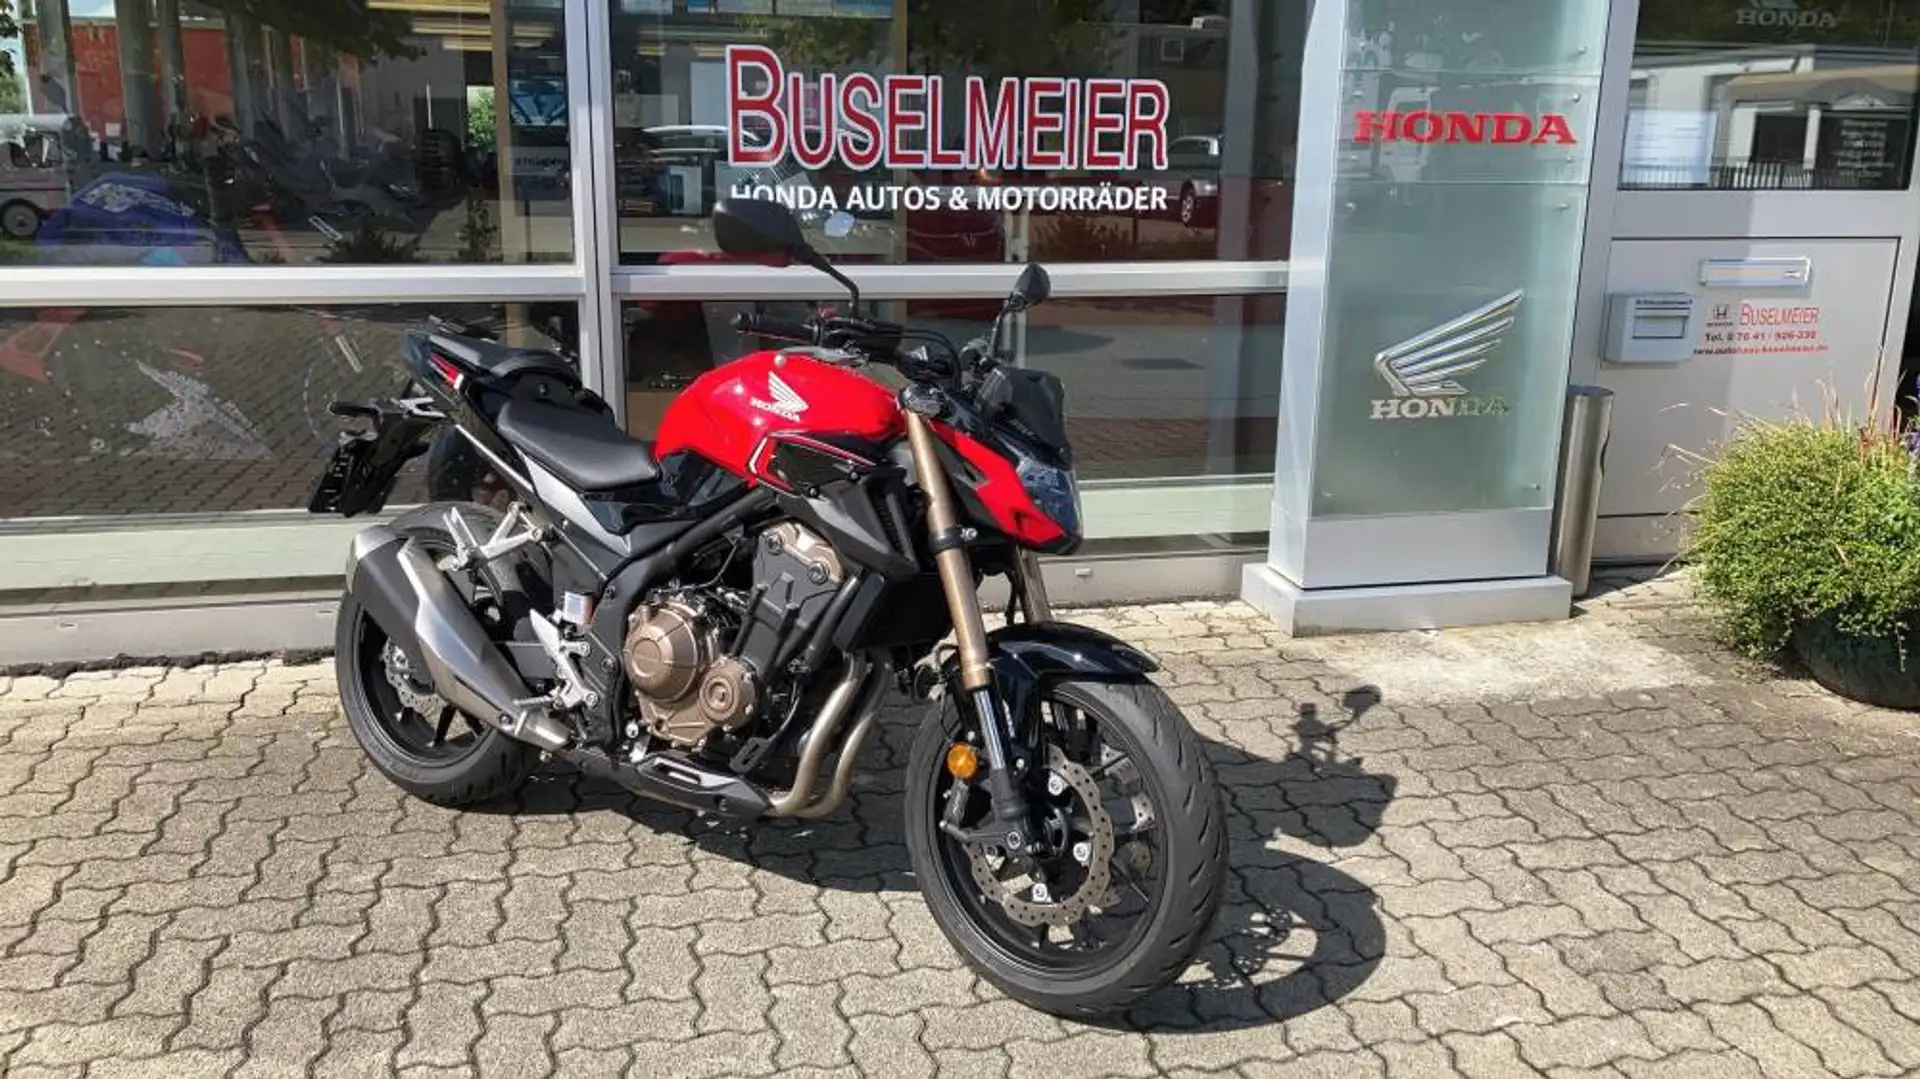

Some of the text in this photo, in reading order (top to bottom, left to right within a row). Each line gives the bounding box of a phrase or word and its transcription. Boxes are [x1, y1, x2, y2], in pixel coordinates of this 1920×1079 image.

[1736, 9, 1838, 28] HONDA
[1352, 109, 1578, 146] HONDA
[846, 184, 940, 211] AUTOS
[948, 184, 970, 211] &
[976, 181, 1168, 211] MOTORRÄDER
[749, 396, 801, 423] HONDA
[1368, 397, 1511, 420] HONDA
